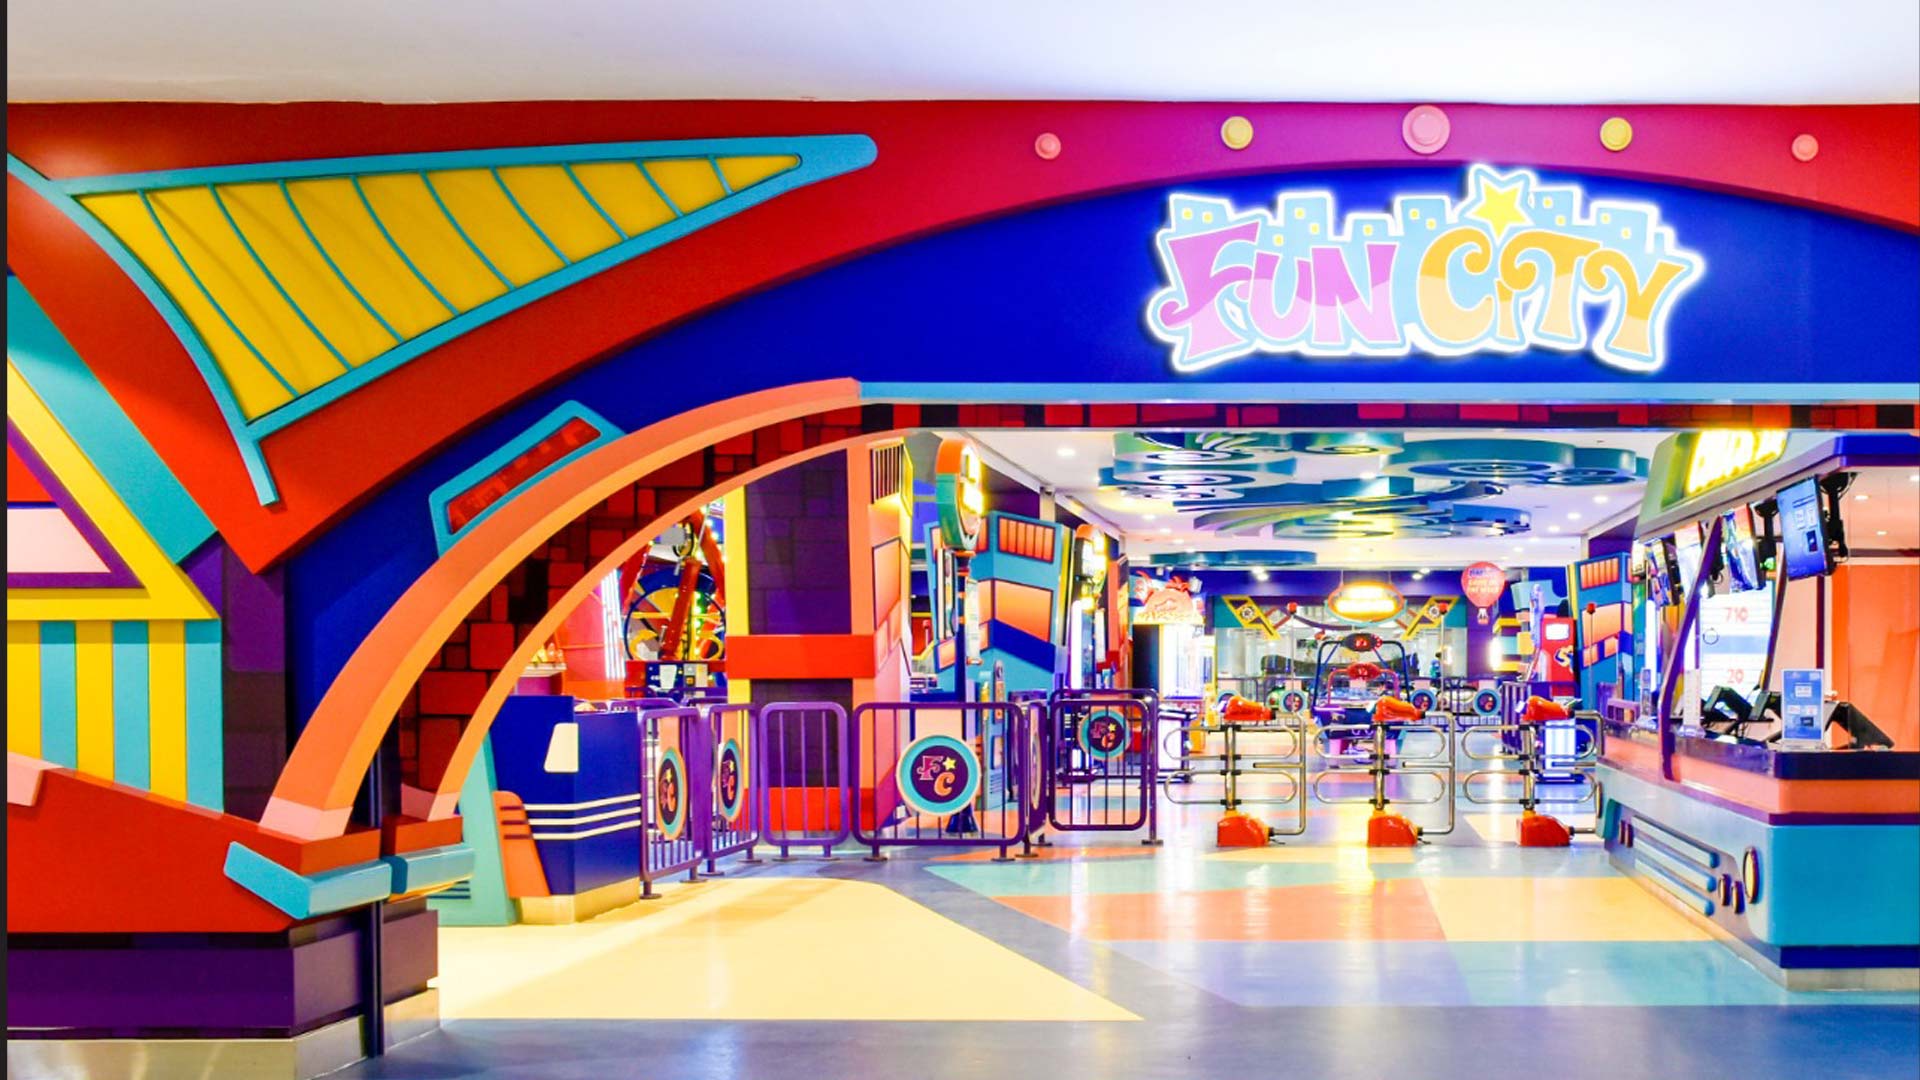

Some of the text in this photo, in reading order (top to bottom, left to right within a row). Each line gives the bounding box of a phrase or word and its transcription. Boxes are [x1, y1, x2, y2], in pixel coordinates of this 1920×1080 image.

[1159, 221, 1686, 359] FUN CITY
[916, 755, 956, 797] FC
